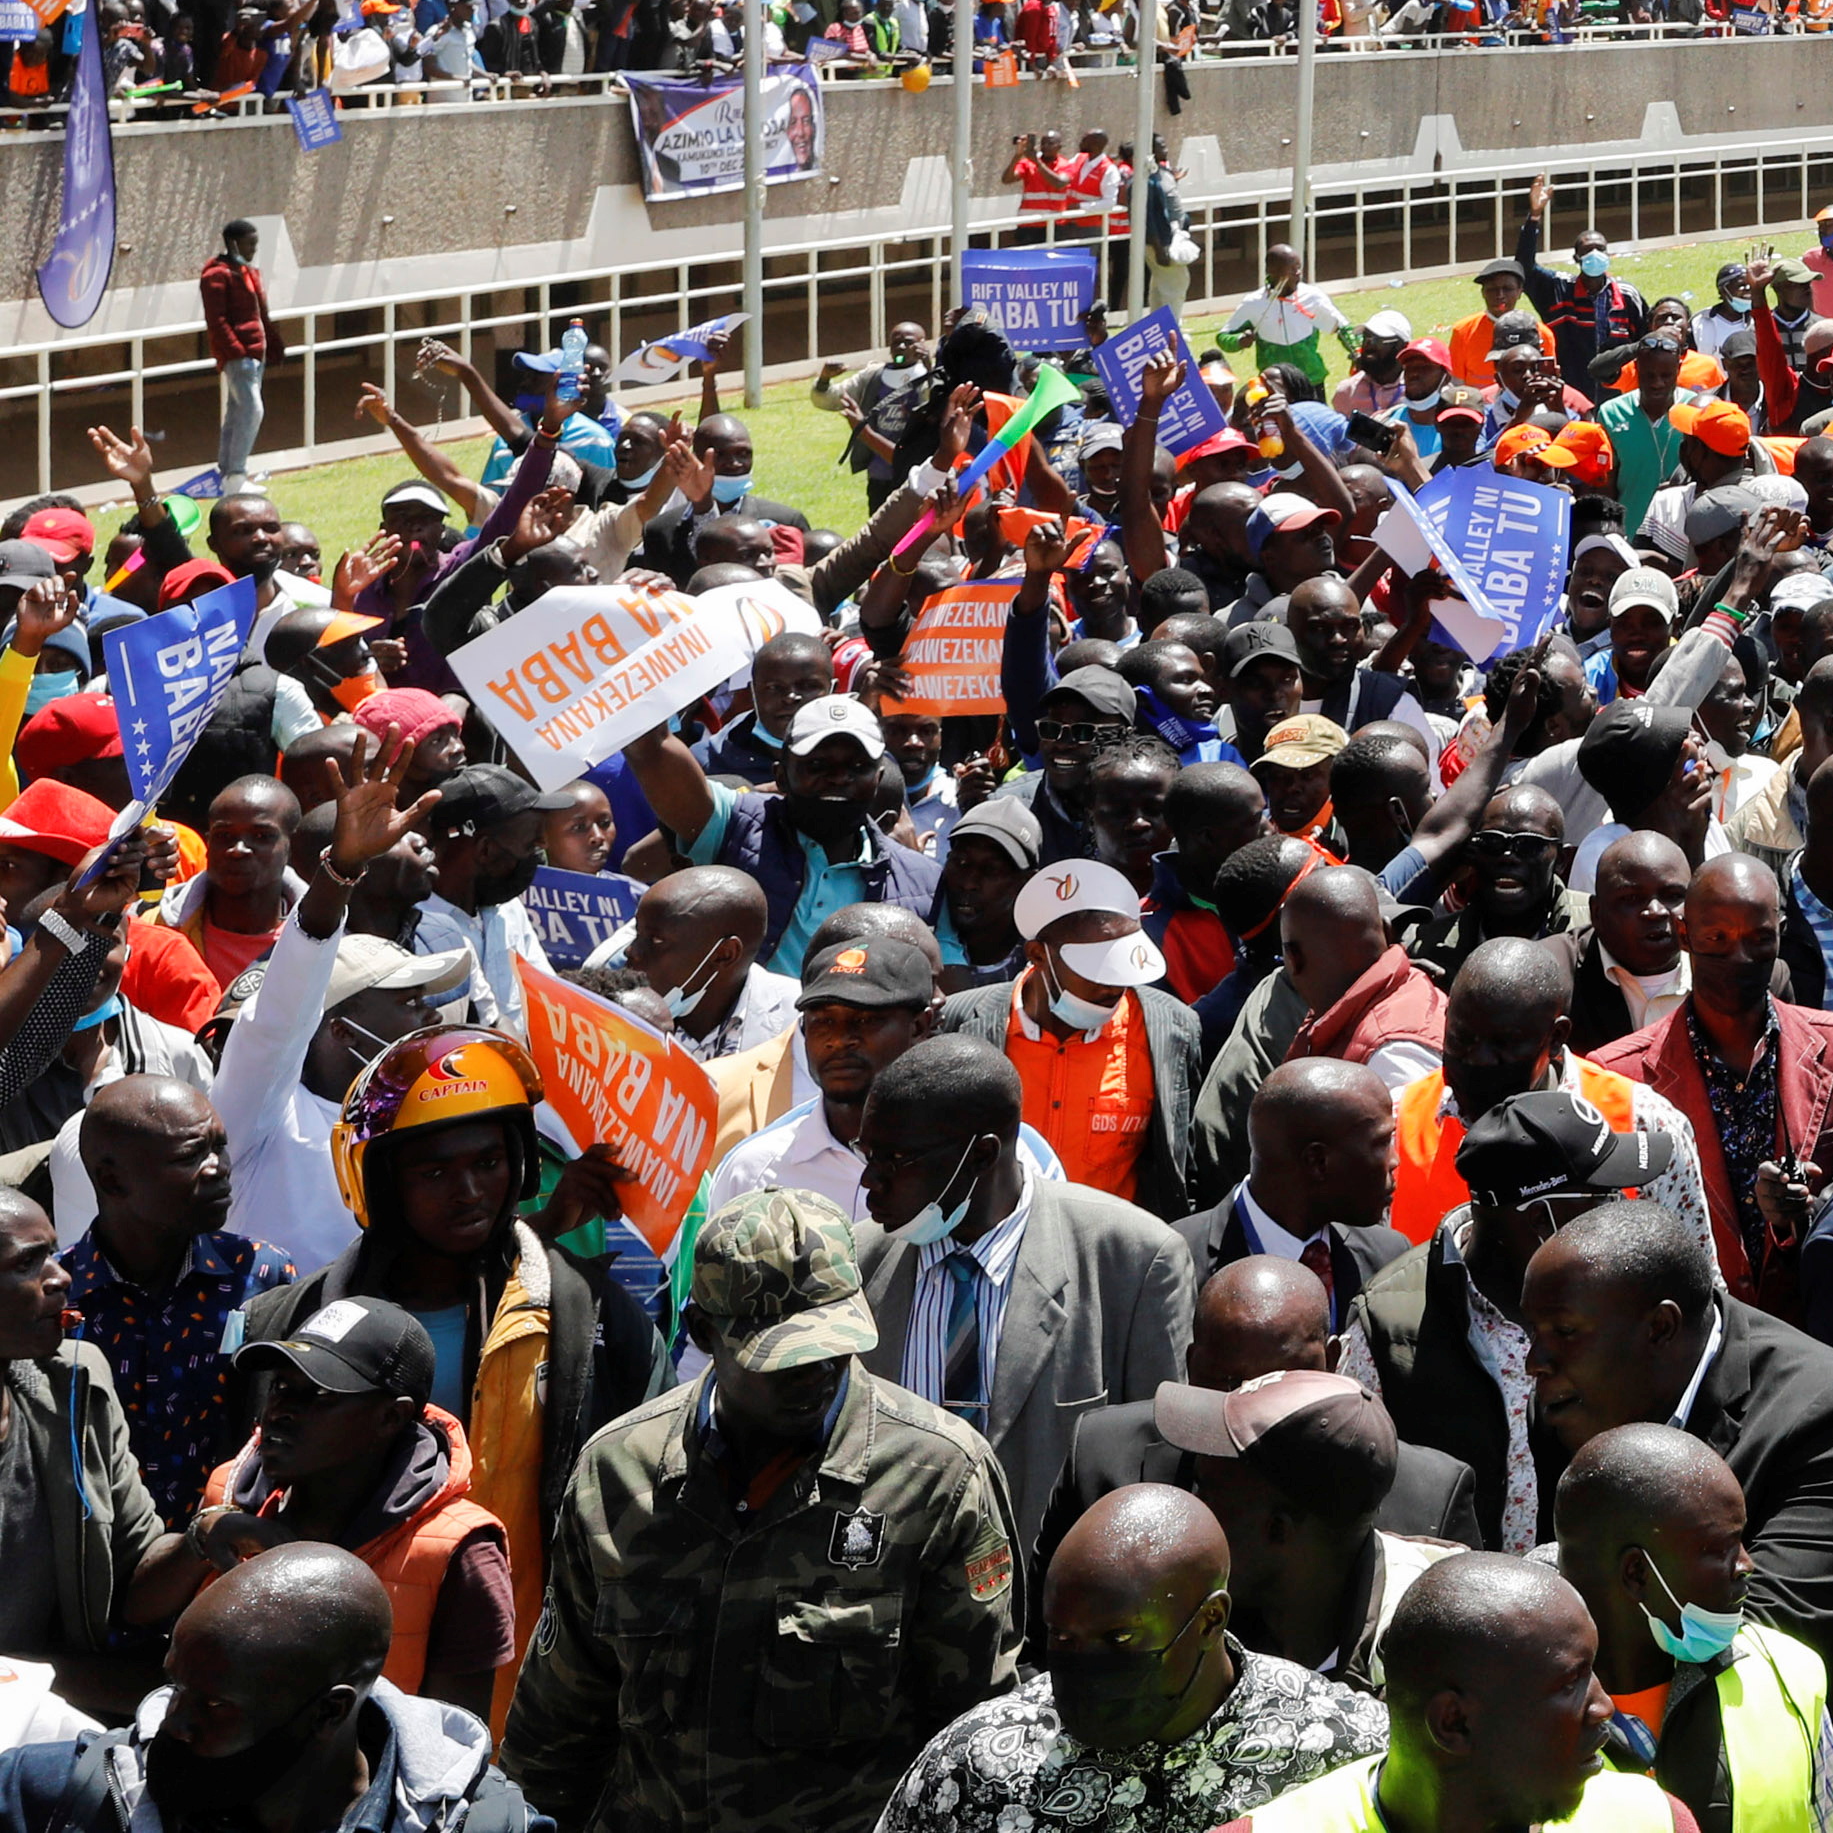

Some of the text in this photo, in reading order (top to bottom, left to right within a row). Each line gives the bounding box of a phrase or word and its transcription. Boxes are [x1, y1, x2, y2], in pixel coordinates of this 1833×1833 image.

[661, 130, 715, 153] AZIMIO
[717, 128, 734, 145] LA
[972, 281, 1078, 301] RIFT VALLEY NI
[1047, 299, 1079, 328] TU
[1158, 405, 1190, 447] TU
[1183, 409, 1208, 435] NI
[1474, 485, 1500, 508] NI
[1496, 489, 1542, 536] TU
[1247, 626, 1273, 650] NY
[489, 589, 695, 723] NA BABA
[535, 623, 714, 751] INAWEZEKANA
[597, 896, 622, 918] NI
[418, 1080, 490, 1103] CAPTAIN
[548, 986, 711, 1175] BABA NA
[1092, 1113, 1118, 1132] GDS
